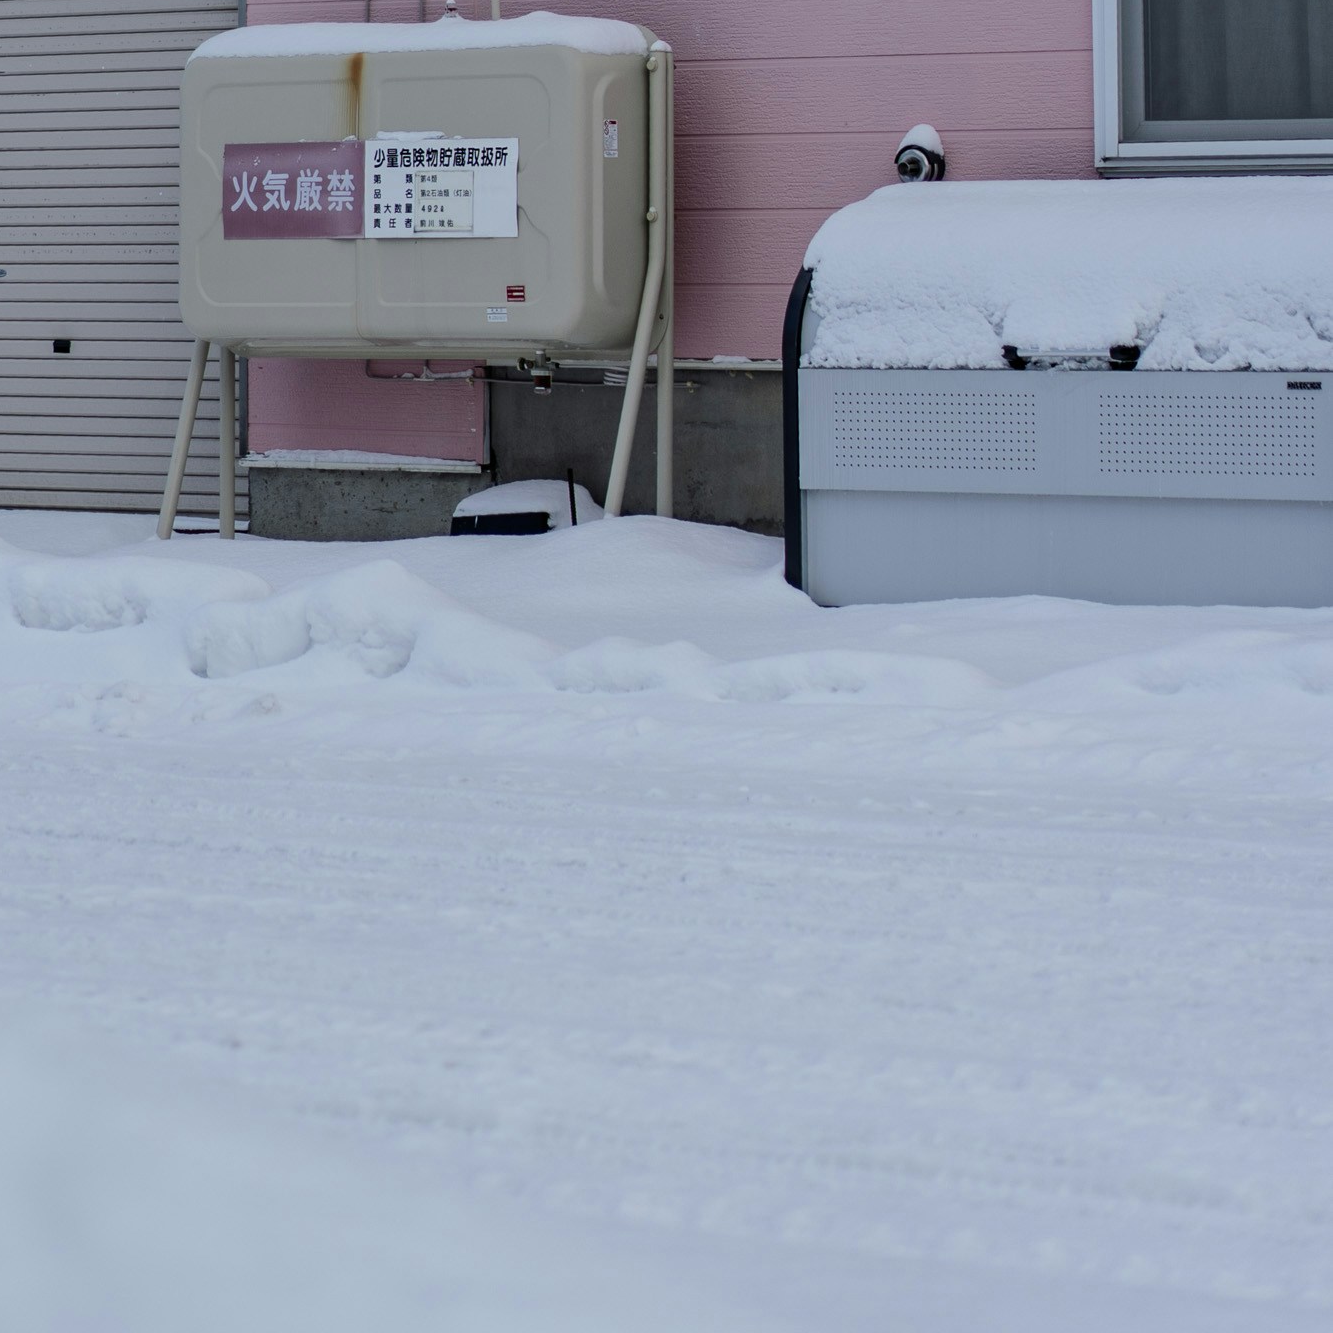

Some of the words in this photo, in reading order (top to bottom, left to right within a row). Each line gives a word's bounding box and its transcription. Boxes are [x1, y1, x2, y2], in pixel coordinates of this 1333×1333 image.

[374, 146, 509, 168] 少量危険物貯蔵取扱所
[231, 168, 356, 212] 火気厳禁
